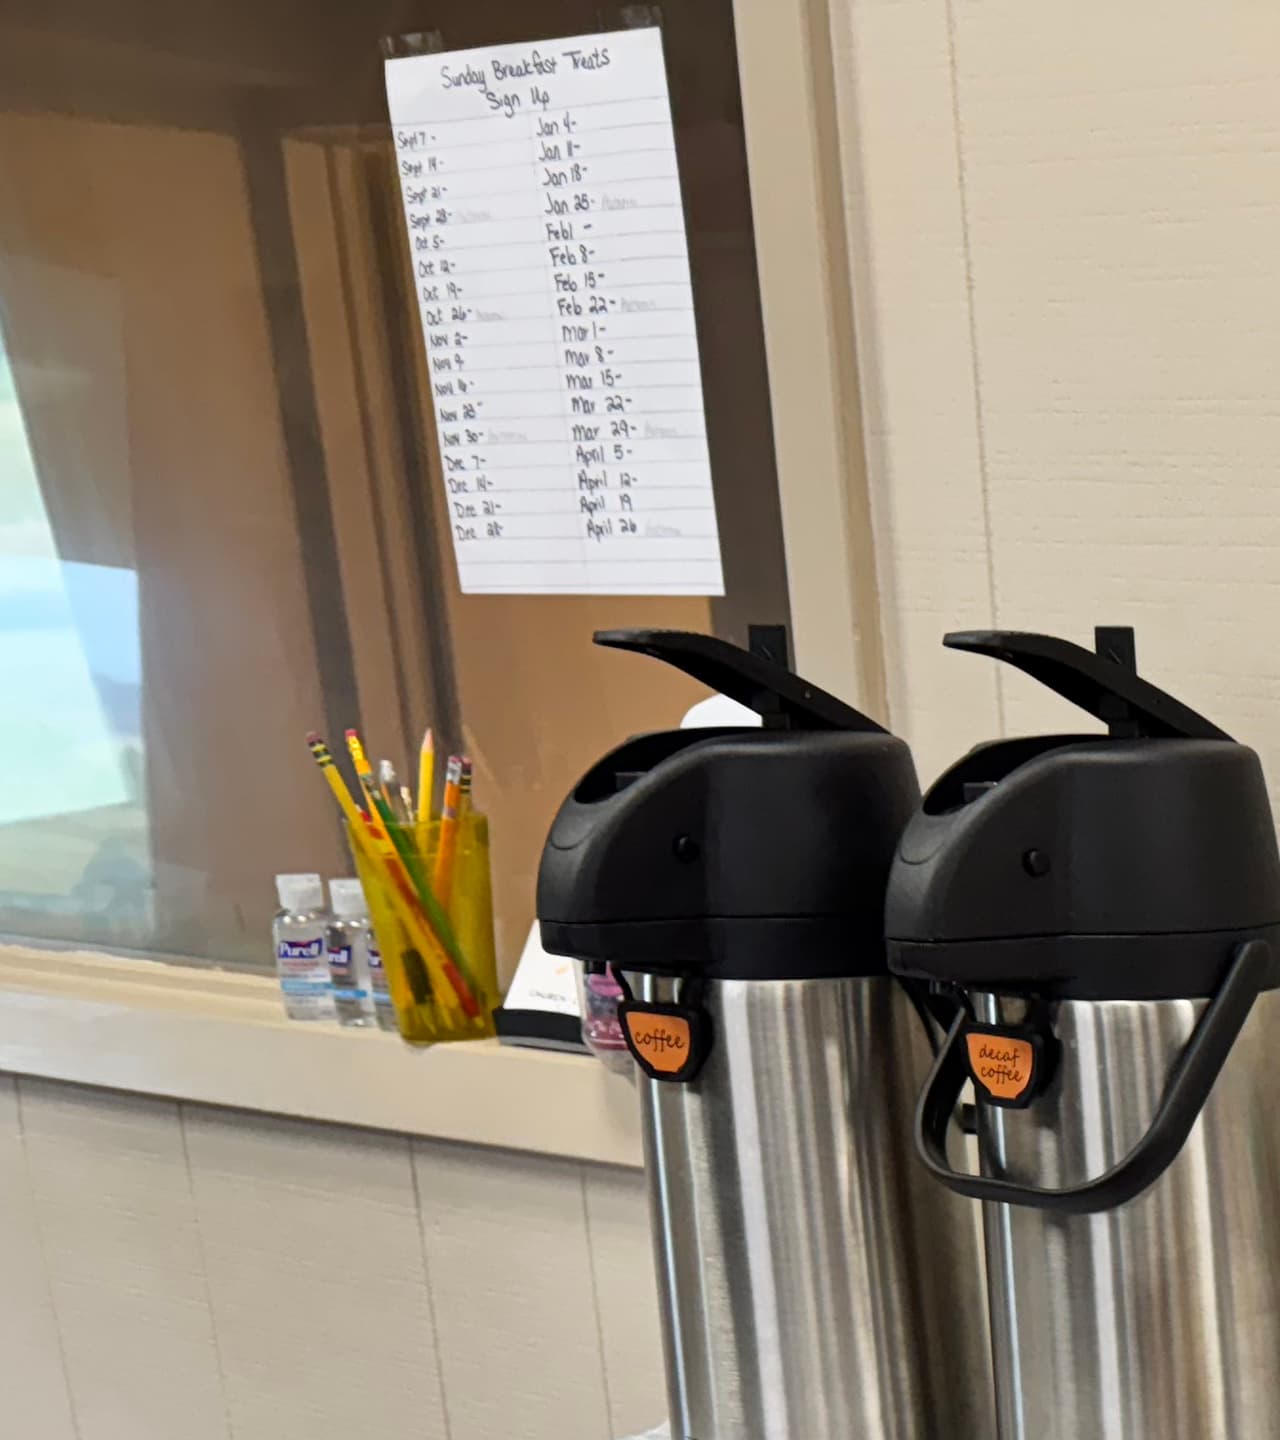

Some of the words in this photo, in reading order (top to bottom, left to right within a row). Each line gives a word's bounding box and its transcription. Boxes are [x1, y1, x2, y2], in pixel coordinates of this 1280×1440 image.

[440, 63, 487, 93] Sunday
[491, 50, 557, 80] Breakfast
[562, 48, 610, 70] Treats
[486, 91, 520, 118] Sign
[530, 86, 550, 112] Up
[537, 117, 559, 136] Jan
[539, 140, 561, 161] Jan
[543, 168, 567, 186] Jan
[545, 192, 568, 214] Jan
[634, 1028, 685, 1051] coffee
[979, 1046, 1021, 1066] decaf
[980, 1064, 1023, 1085] coffee
